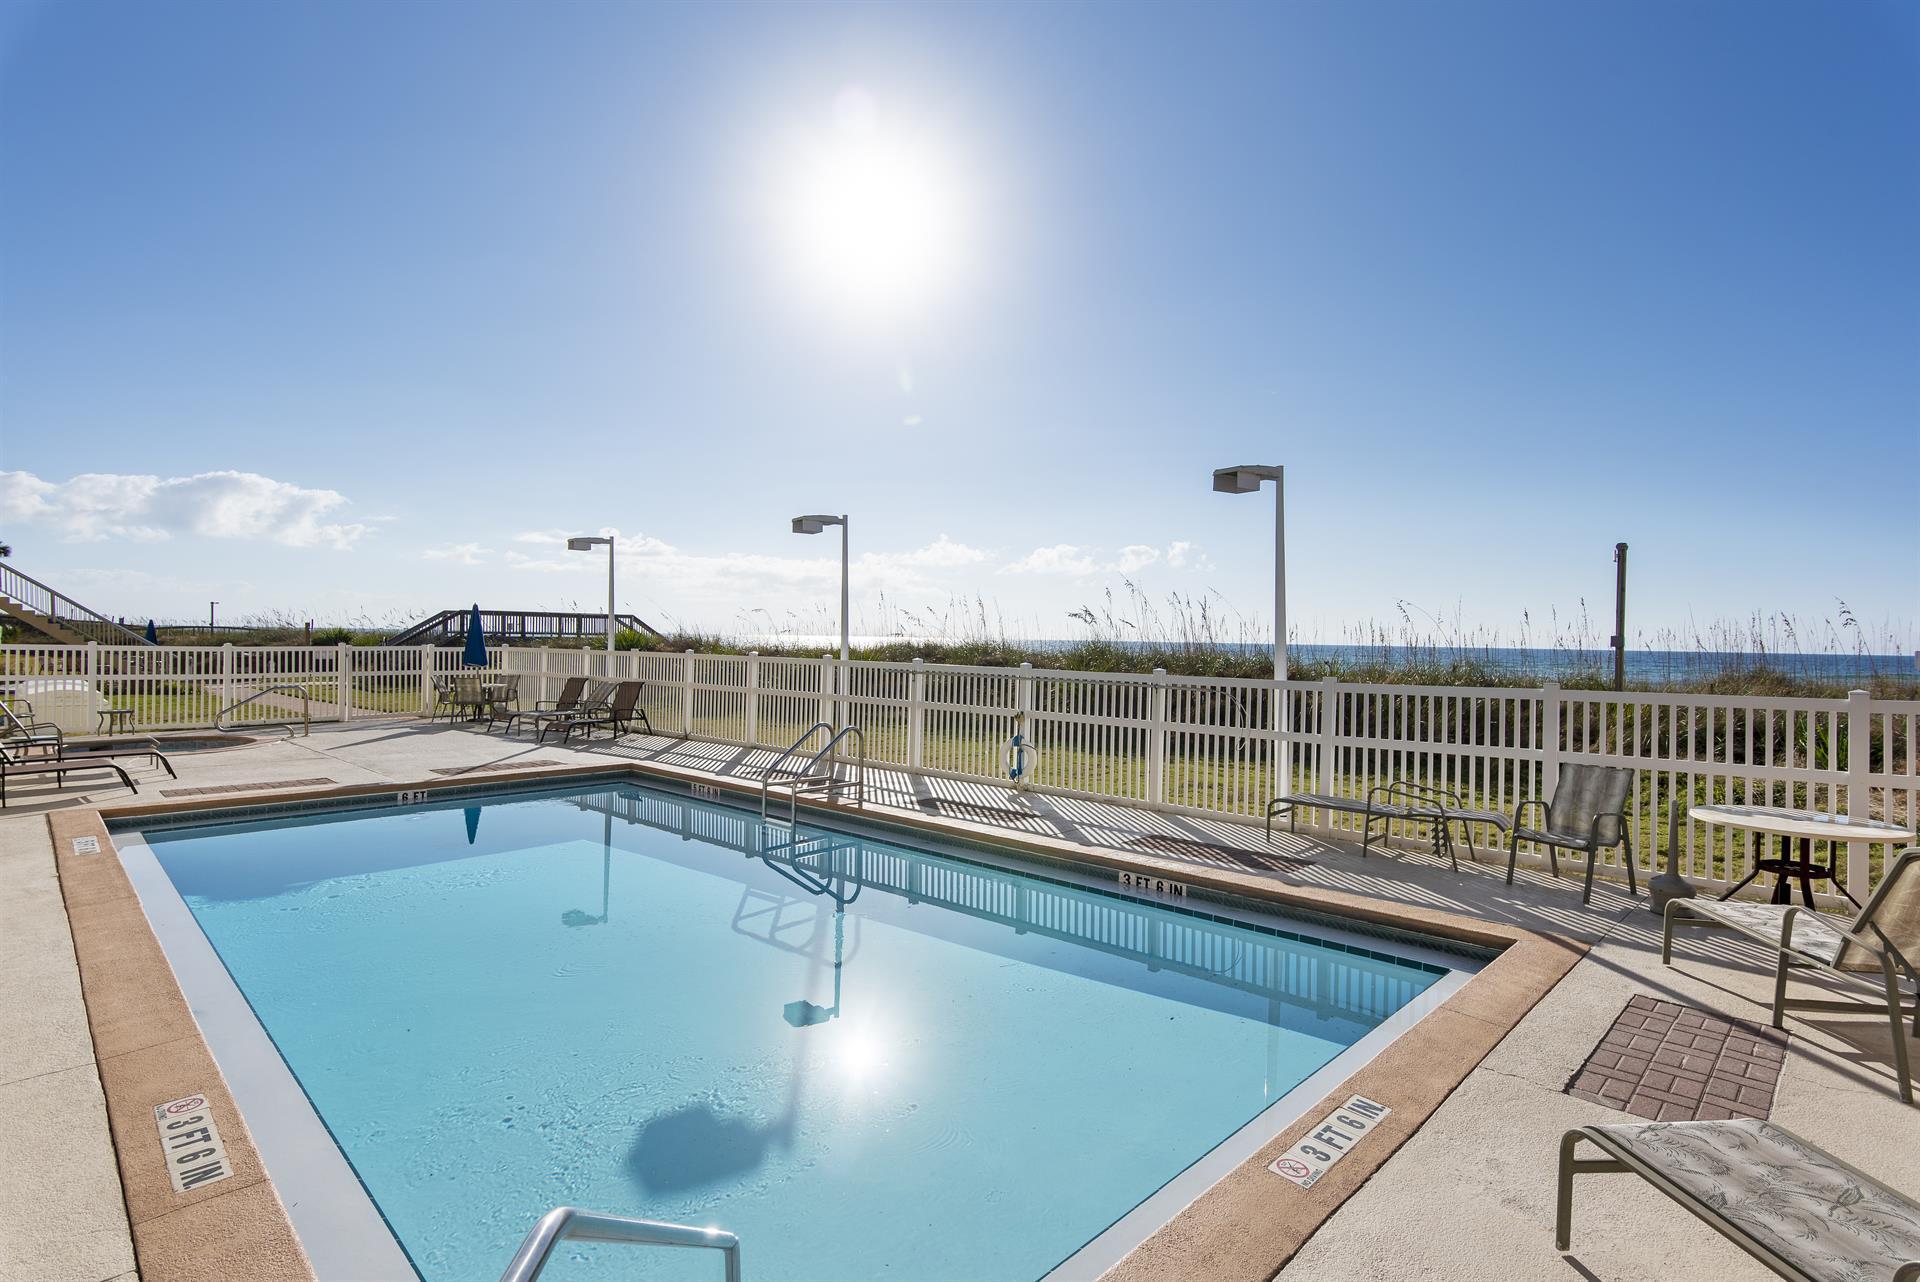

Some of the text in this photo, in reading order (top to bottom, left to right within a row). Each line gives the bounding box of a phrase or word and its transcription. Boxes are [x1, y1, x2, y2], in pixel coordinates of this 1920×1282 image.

[402, 791, 426, 801] 6 FT
[1123, 873, 1183, 896] 3 FT 6 IN
[1300, 1098, 1386, 1162] 3 FT 6 IN.
[167, 1115, 225, 1190] 3 FT 6 IN.
